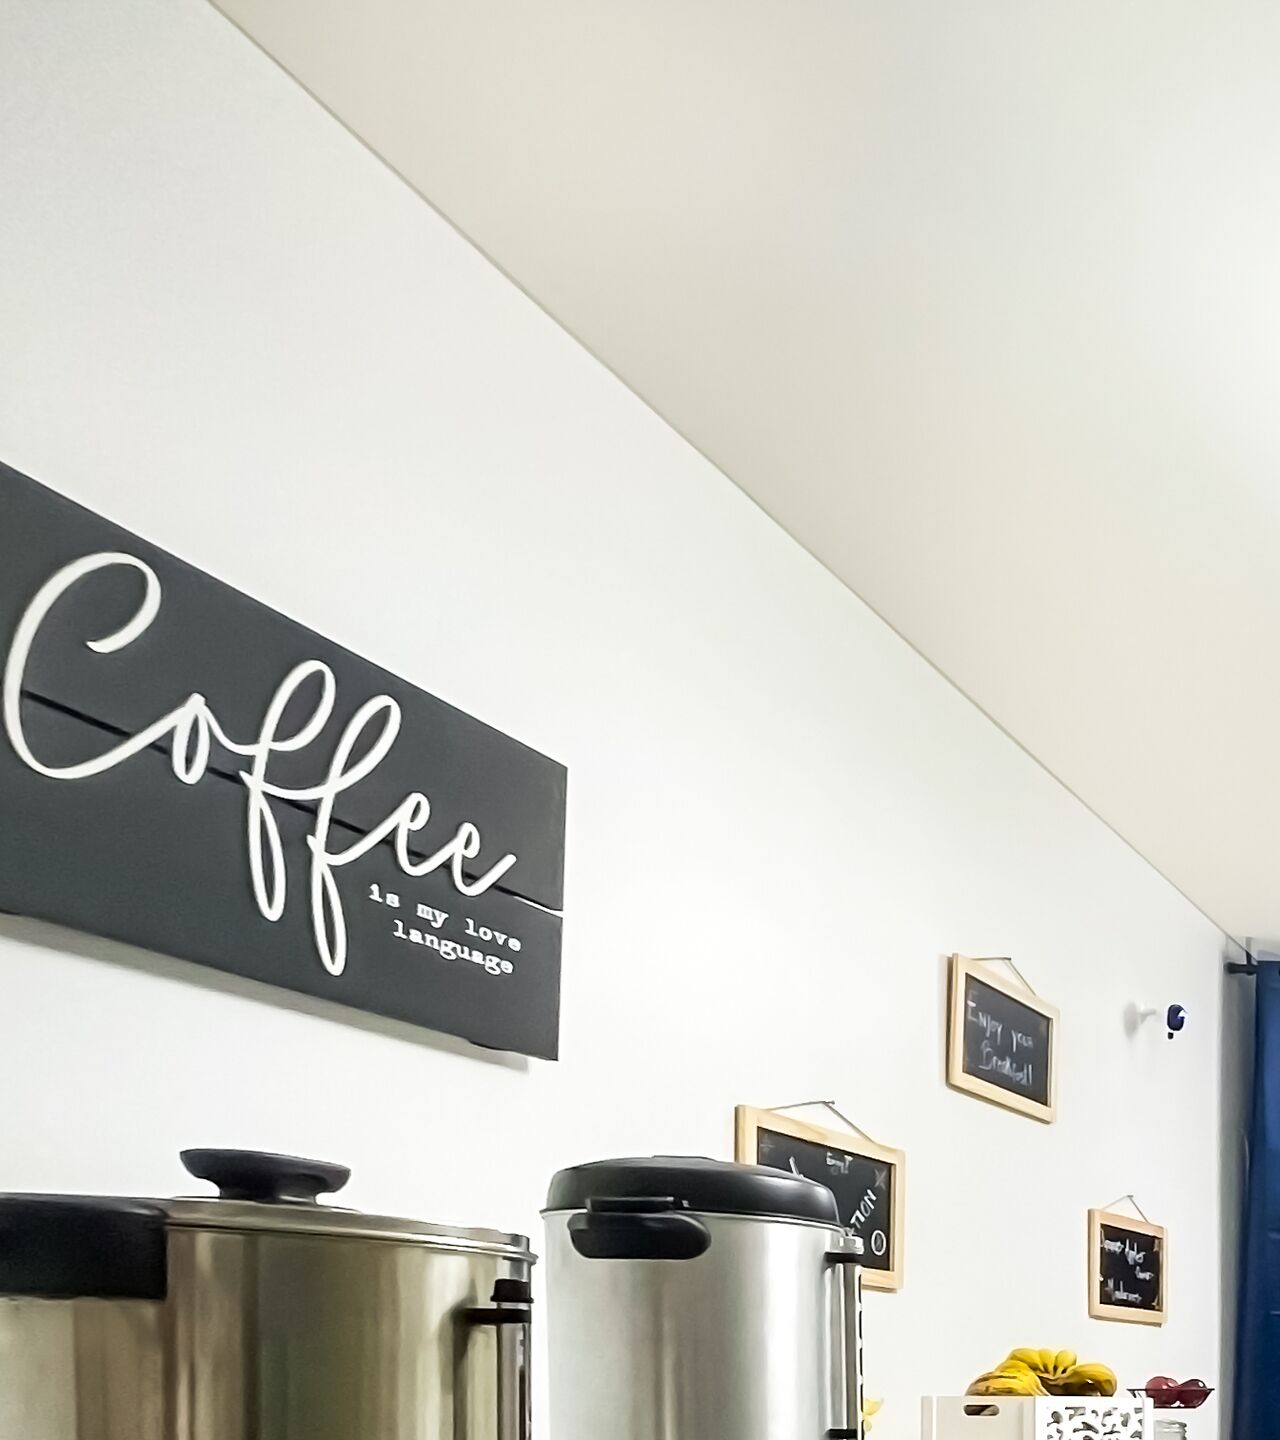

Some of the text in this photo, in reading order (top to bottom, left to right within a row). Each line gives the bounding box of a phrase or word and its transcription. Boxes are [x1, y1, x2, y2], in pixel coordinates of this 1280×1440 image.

[3, 551, 517, 977] Coffee
[369, 883, 522, 952] is my love
[393, 919, 514, 976] language
